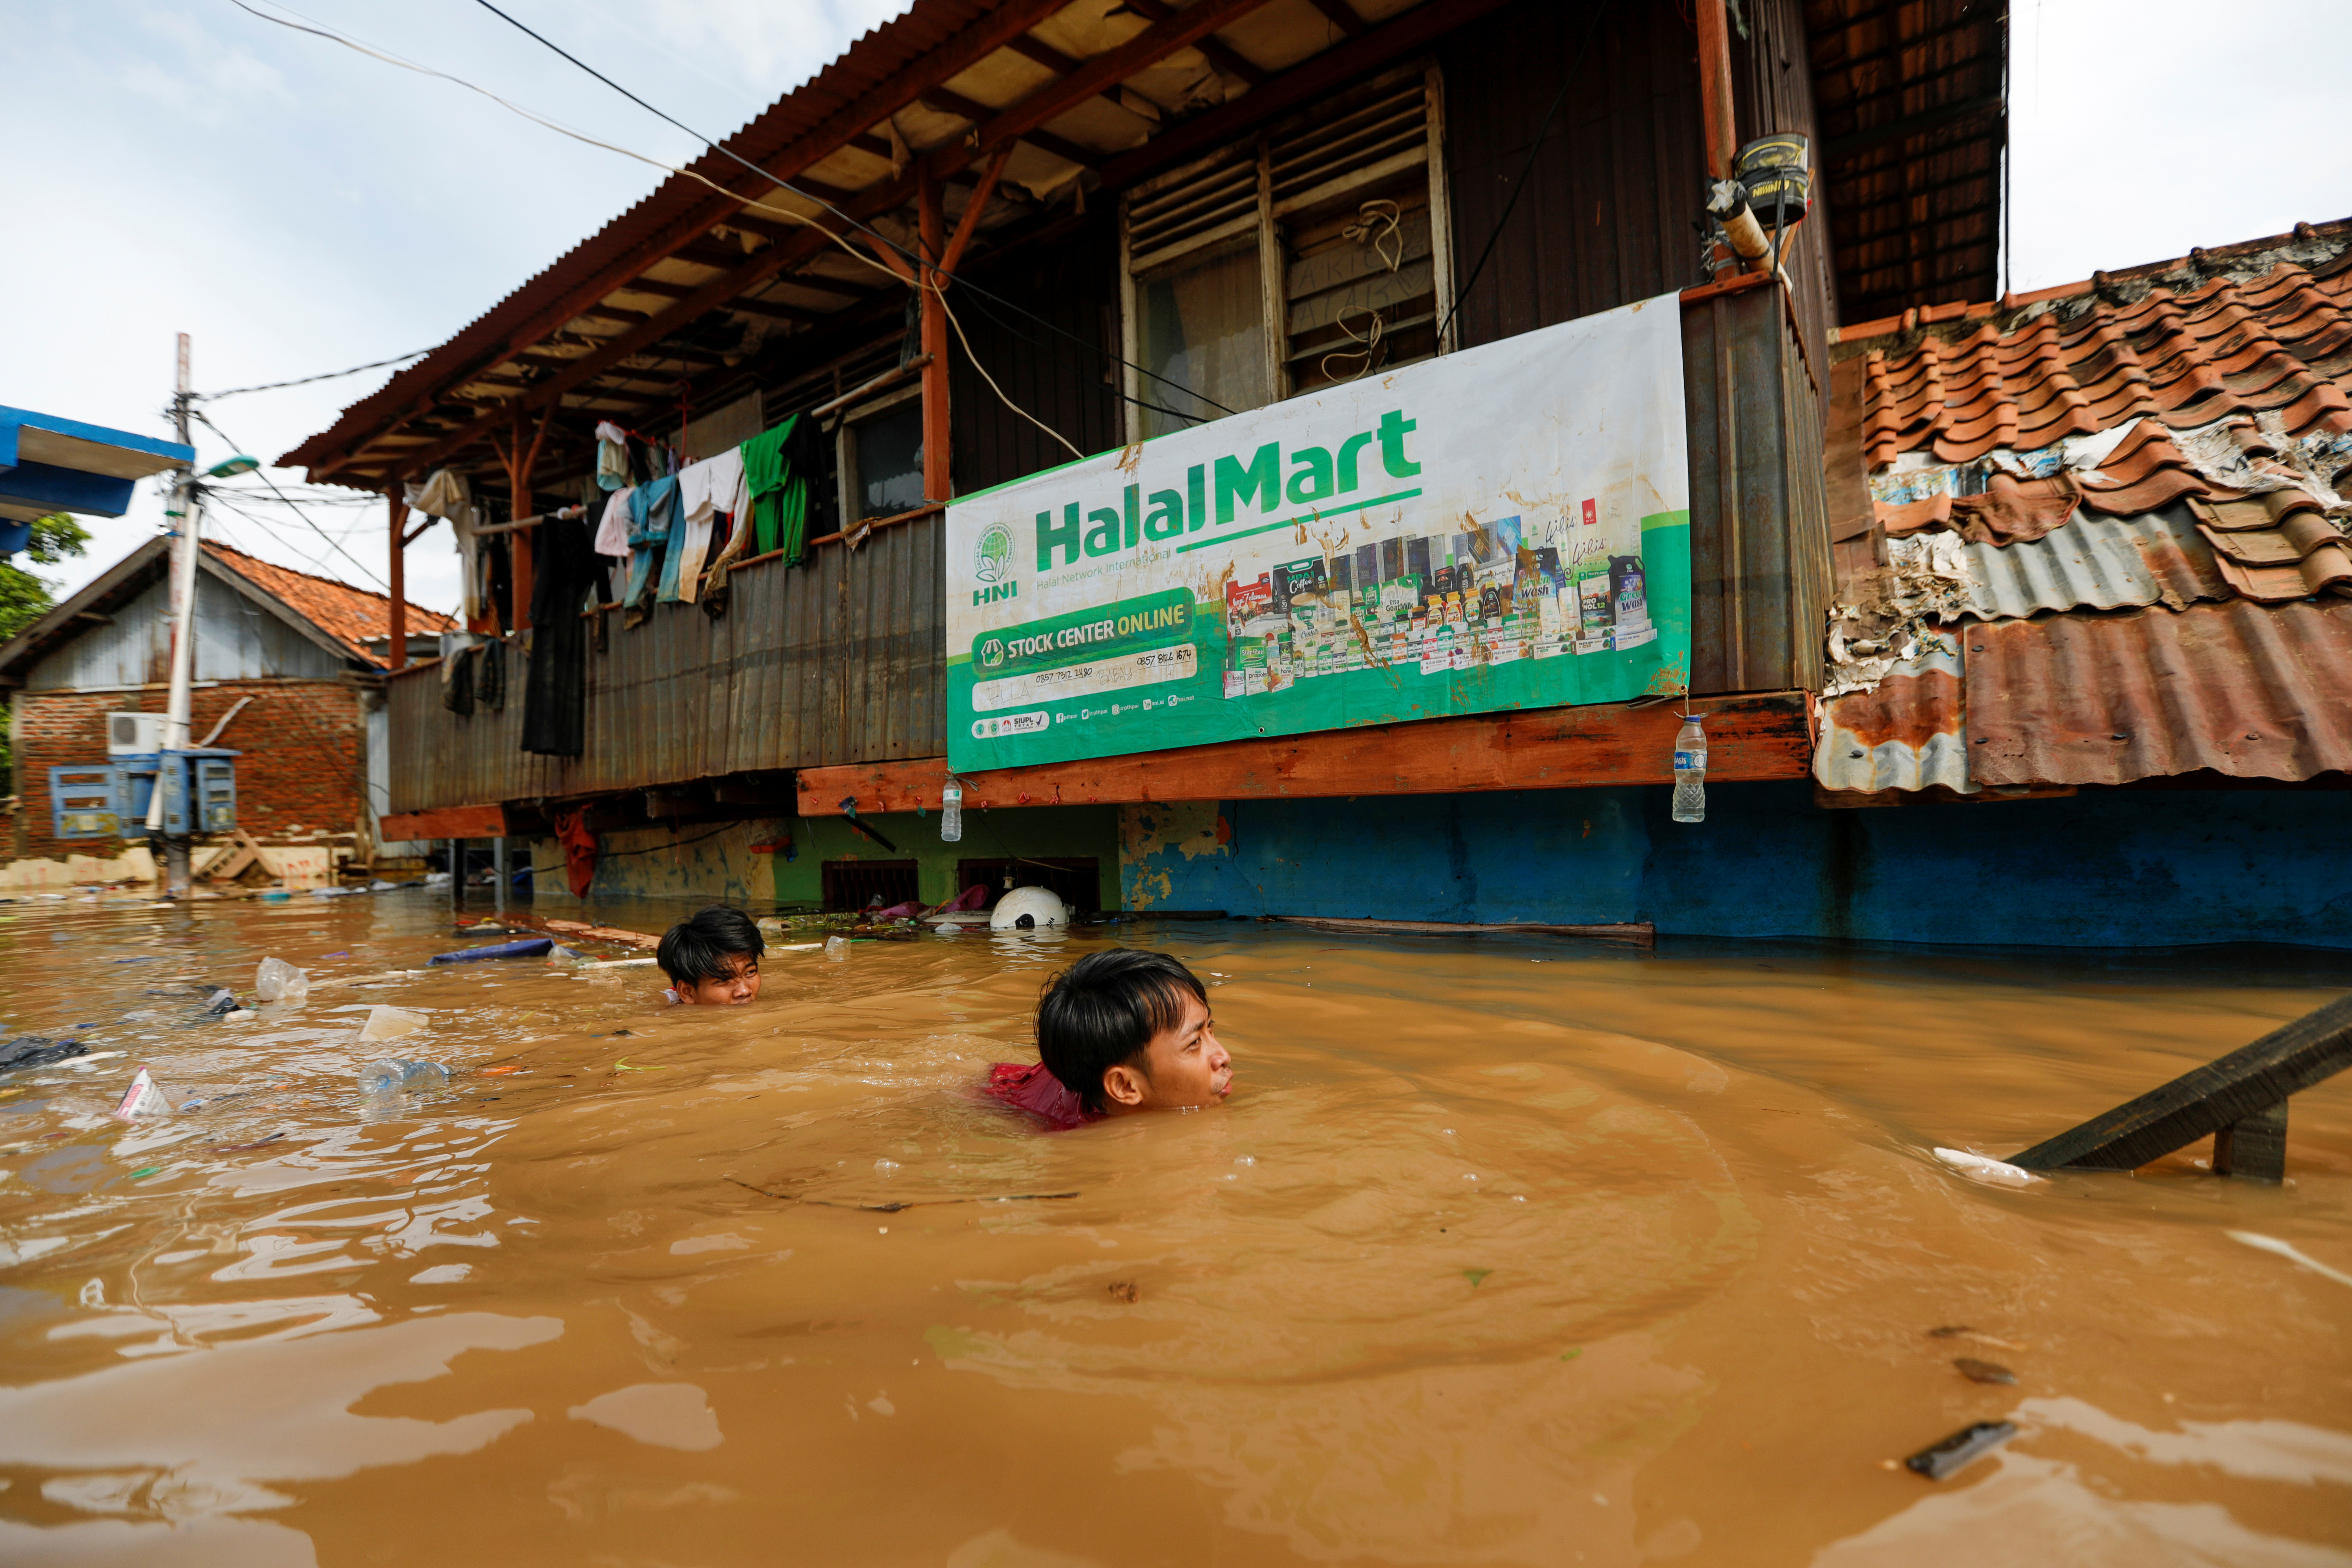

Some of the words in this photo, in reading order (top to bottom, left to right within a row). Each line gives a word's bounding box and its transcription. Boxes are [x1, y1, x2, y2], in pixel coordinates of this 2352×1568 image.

[1037, 409, 1422, 572] HalalMart
[977, 526, 996, 549] NETWORK
[996, 525, 1012, 563] INTERNATIONAL
[1037, 577, 1059, 590] Halal
[1062, 565, 1102, 584] Network
[1106, 546, 1171, 573] International
[1287, 571, 1315, 583] HPAI
[973, 580, 1017, 607] HNI
[1289, 578, 1313, 594] Coffee
[1521, 585, 1549, 598] Wash
[1233, 596, 1245, 607] kopi
[1244, 593, 1250, 604] 7
[1249, 591, 1268, 601] elemen
[1619, 590, 1643, 602] Green
[1386, 602, 1414, 611] GoatMilk
[1622, 598, 1643, 612] Wash
[1008, 632, 1054, 659] STOCK
[1057, 619, 1115, 648] CENTER
[1118, 603, 1185, 635] ONLINE
[1301, 628, 1319, 639] Centella
[1137, 655, 1155, 666] 0857
[1176, 649, 1192, 661] 1674
[1036, 673, 1053, 683] 0857
[1056, 671, 1073, 681] 7312
[1075, 667, 1093, 678] 2480
[1096, 666, 1133, 686] BABAY
[1248, 671, 1267, 681] propolis
[986, 680, 1031, 705] ELLA
[1089, 708, 1108, 717] @pthpai
[1120, 703, 1139, 712] @pthpai
